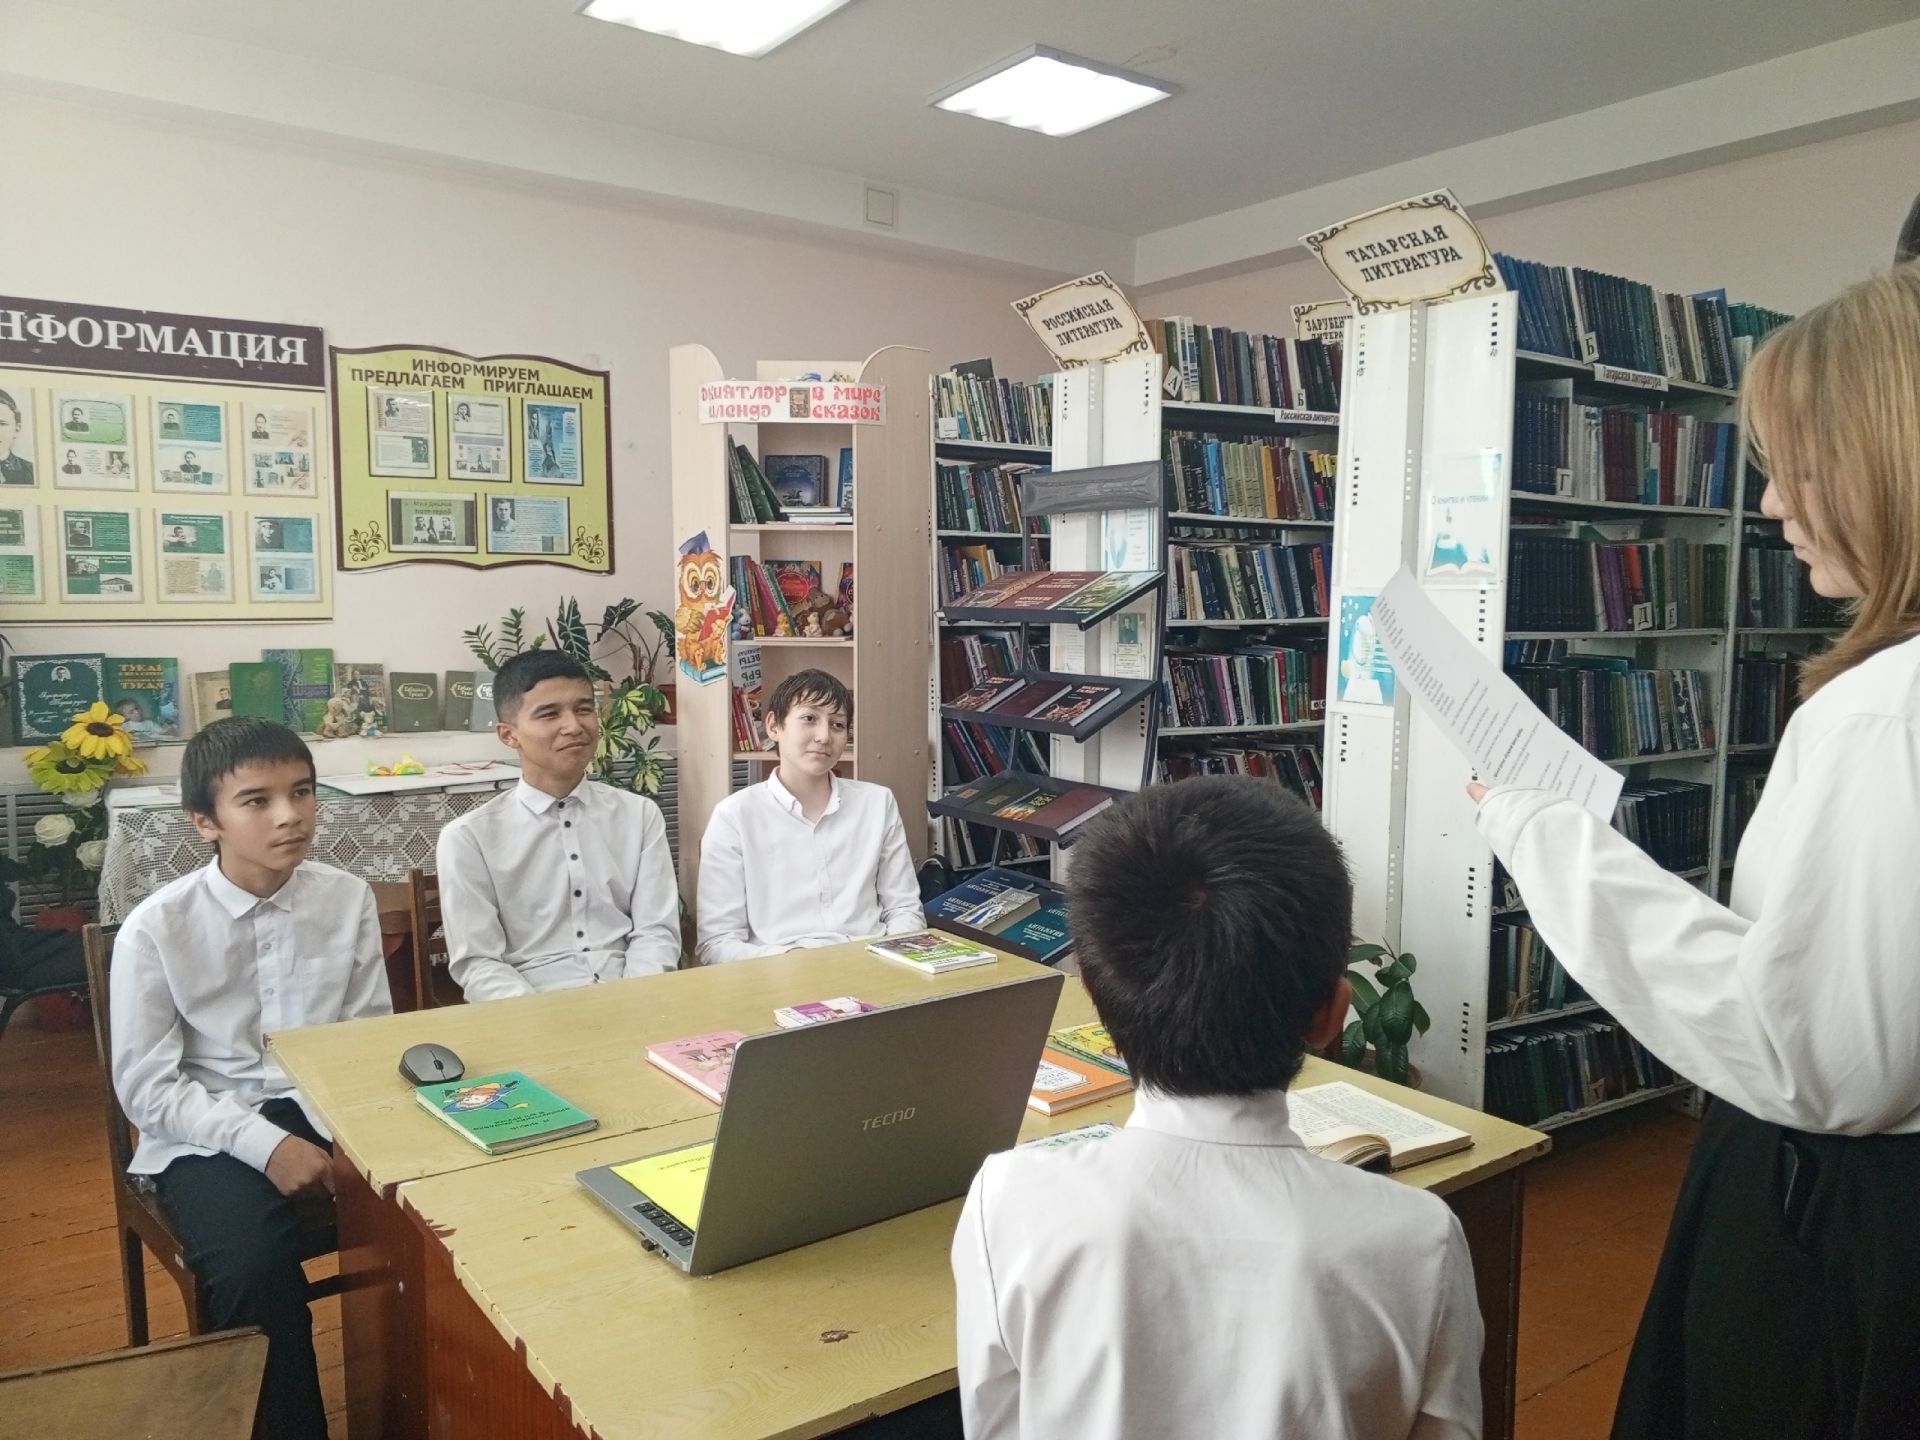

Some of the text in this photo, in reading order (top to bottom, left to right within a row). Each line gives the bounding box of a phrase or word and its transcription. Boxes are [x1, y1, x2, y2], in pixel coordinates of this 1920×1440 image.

[1347, 225, 1449, 263] ТАТАРСКАЯ
[1360, 246, 1463, 282] ЛИТЕРАТУРА
[1042, 298, 1114, 331] РОССИЙСКАЯ
[1056, 316, 1123, 346] ЛИТЕРАТУРА
[1586, 337, 1595, 356] Б
[351, 368, 465, 390] ПРЕДЛАГАЕМ
[412, 358, 540, 382] ИНФОРМИРУЕМ
[483, 379, 593, 400] ПРИГЛАШАЕМ
[1167, 375, 1178, 391] А
[1297, 392, 1304, 407] Б
[862, 1107, 916, 1131] TECNO
